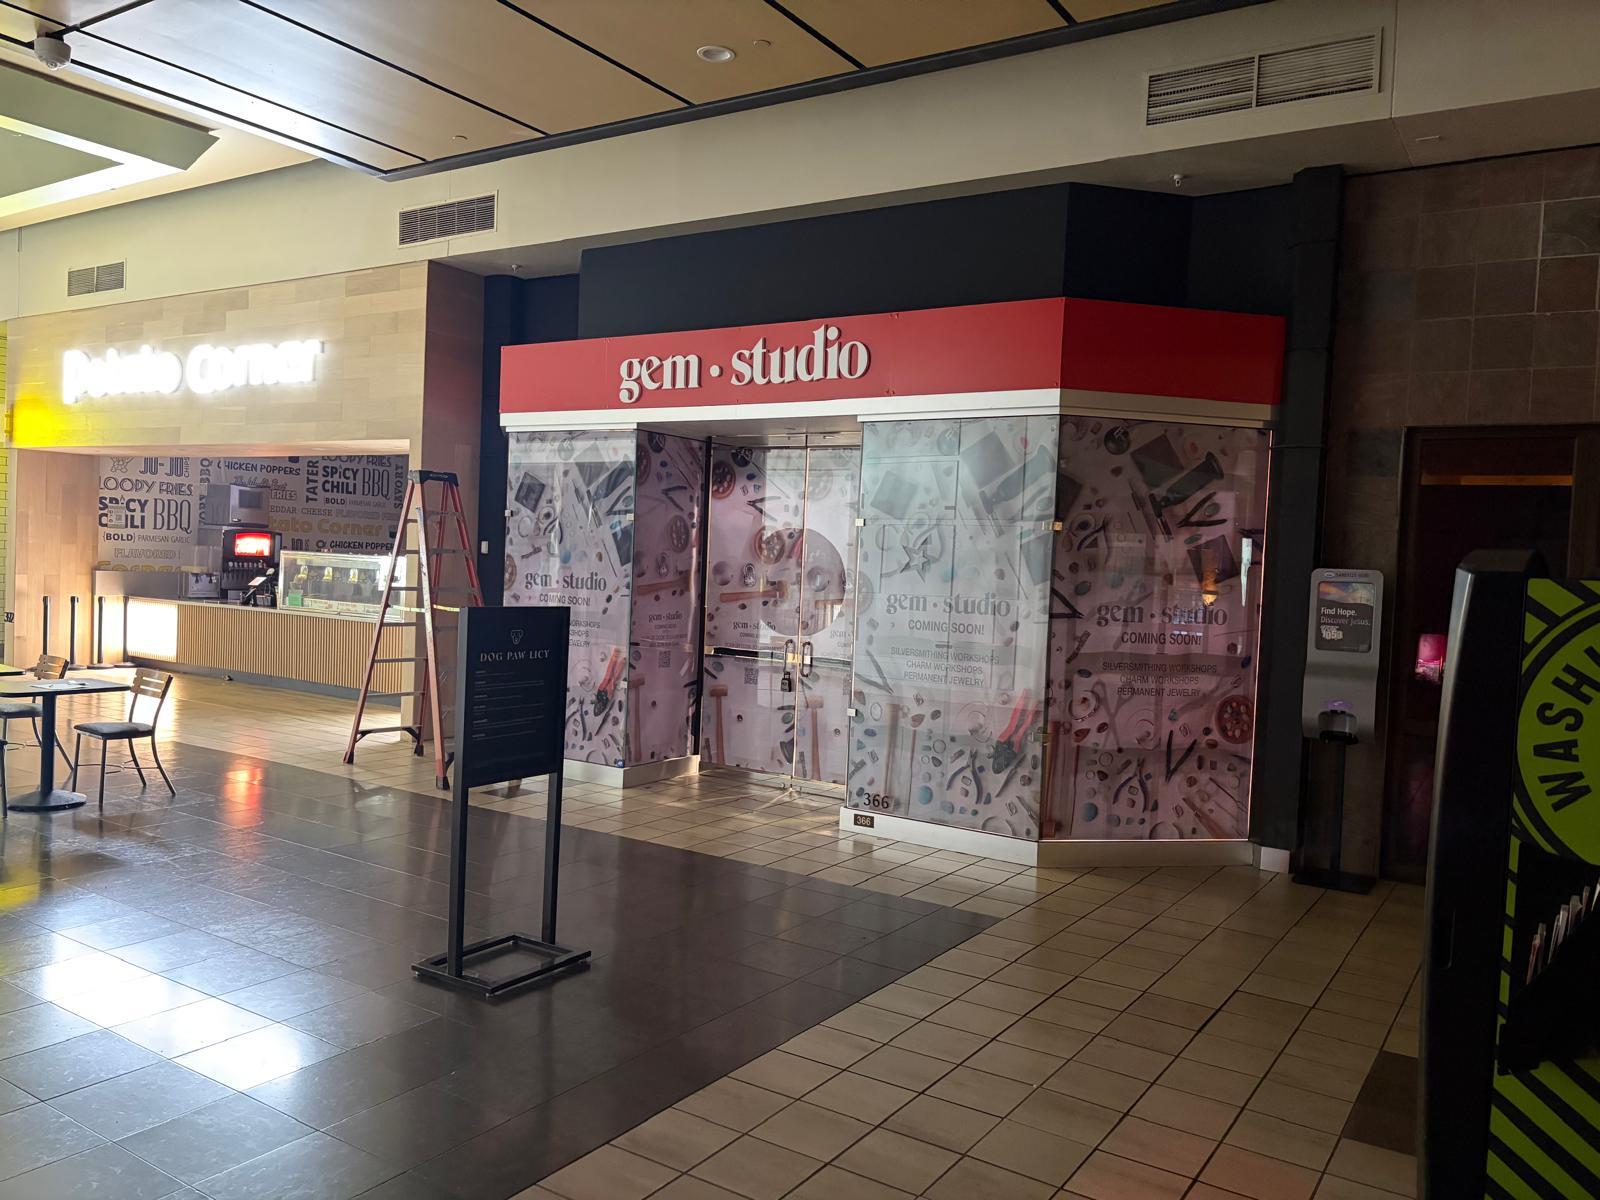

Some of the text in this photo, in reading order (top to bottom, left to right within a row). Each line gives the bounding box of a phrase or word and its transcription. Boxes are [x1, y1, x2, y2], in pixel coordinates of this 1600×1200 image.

[619, 324, 870, 404] gem studio
[260, 464, 301, 477] POPPERS
[159, 481, 194, 496] FRIES
[306, 460, 320, 504] TATER
[362, 467, 391, 500] BBQ
[153, 497, 192, 535] BBQ
[330, 541, 364, 554] CHICKEN
[525, 571, 607, 591] gem studio
[886, 591, 1011, 617] gem studio
[1096, 601, 1228, 627] gem studio
[1321, 607, 1358, 618] Find Hope.
[908, 619, 985, 636] COMING SOON!
[1121, 631, 1202, 646] COMING SOON!
[480, 652, 503, 662] DOG
[507, 651, 526, 661] PAW
[890, 645, 1001, 665] SILVERSMITHING WORKSHOPS
[905, 659, 983, 675] CHARM WORKSHOPS
[1102, 661, 1217, 674] SILVERSMITHING WORKSHOPS
[948, 675, 985, 688] JEWELRY
[1120, 675, 1200, 686] CHARM WORKSHOPS
[1117, 686, 1202, 698] PERMANENT JEWELRY
[863, 792, 890, 809] 366
[856, 816, 871, 826] 366
